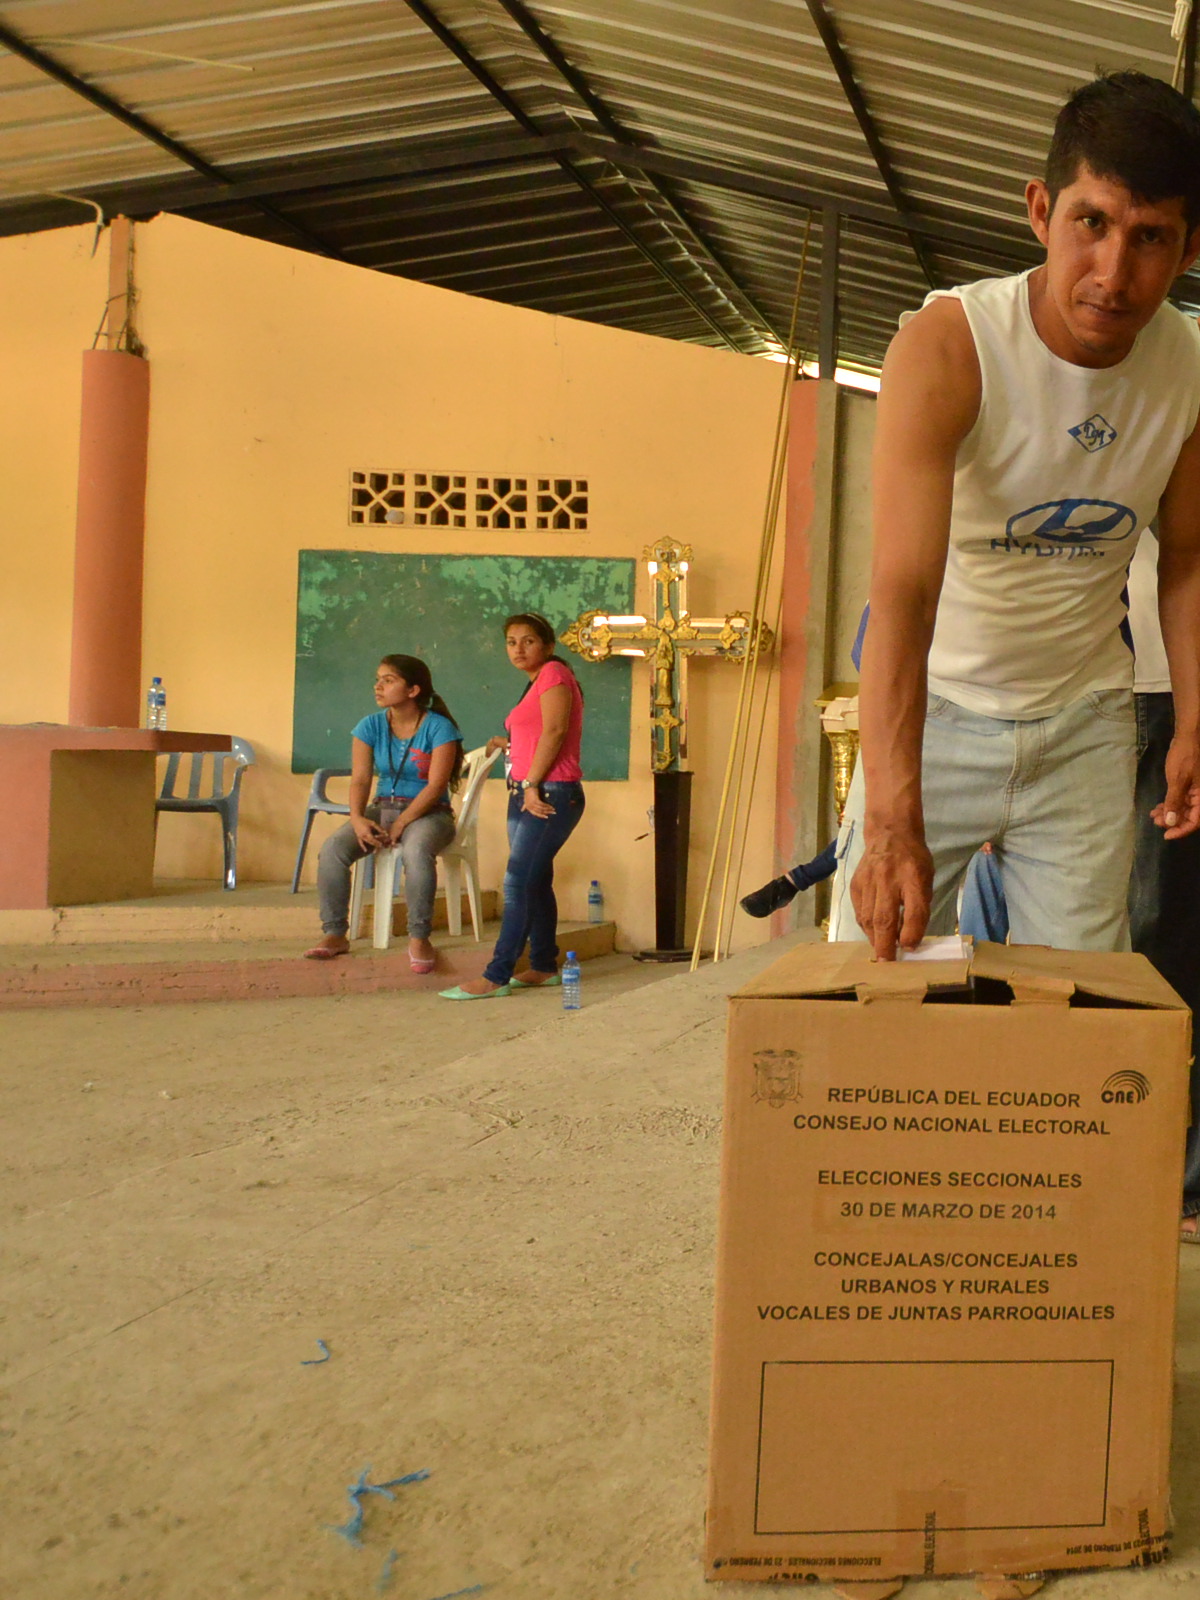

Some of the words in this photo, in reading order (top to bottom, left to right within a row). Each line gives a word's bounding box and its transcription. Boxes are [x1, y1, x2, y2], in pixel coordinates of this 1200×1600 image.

[828, 1085, 939, 1104] REPÚBLICA
[945, 1090, 981, 1105] DEL
[987, 1091, 1081, 1107] ECUADOR
[1101, 1090, 1135, 1104] CNE
[793, 1114, 888, 1131] CONSEJO
[894, 1116, 993, 1133] NACIONAL
[998, 1118, 1111, 1135] ELECTORAL
[818, 1170, 942, 1187] ELECCIONES
[948, 1171, 1082, 1188] SECCIONALES
[840, 1202, 863, 1217] 30
[869, 1203, 896, 1218] DE
[901, 1203, 974, 1219] MARZO
[980, 1204, 1006, 1219] DE
[1011, 1204, 1056, 1220] 2014
[814, 1251, 1078, 1268] CONCEJALAS/CONCEJALES
[841, 1279, 937, 1295] URBANOS
[943, 1279, 955, 1294] Y
[960, 1279, 1050, 1295] RURALES
[757, 1305, 850, 1320] VOCALES
[857, 1305, 882, 1320] DE
[887, 1305, 961, 1321] JUNTAS
[968, 1305, 1115, 1321] PARROQUIALES
